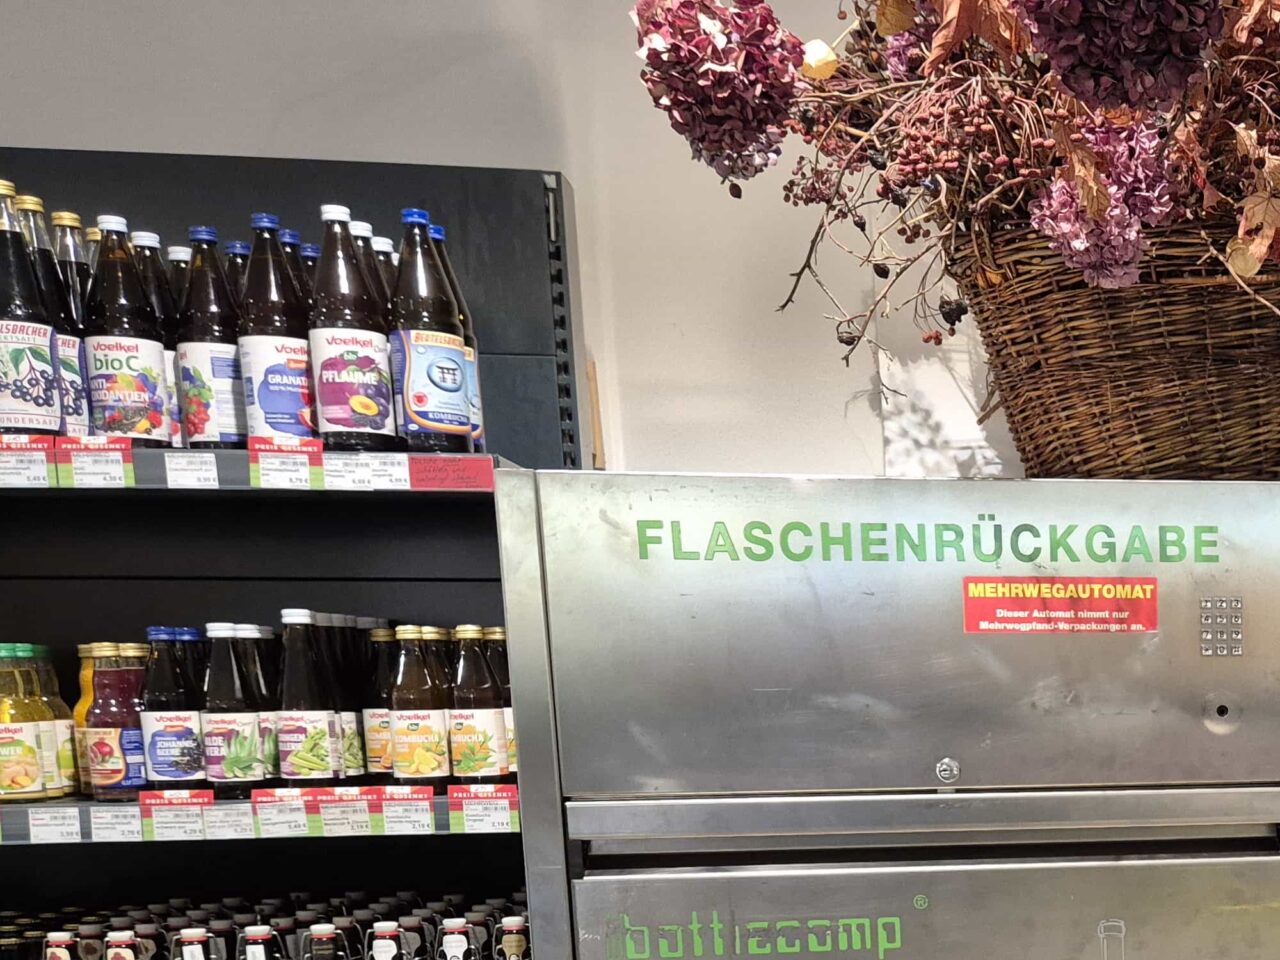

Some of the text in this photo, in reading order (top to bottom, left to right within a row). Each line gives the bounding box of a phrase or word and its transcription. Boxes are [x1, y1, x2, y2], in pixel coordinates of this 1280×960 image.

[93, 353, 140, 372] bio C
[322, 370, 378, 385] PFLAUME
[636, 514, 1221, 563] FLASCHENRÜCKGABE
[968, 582, 1154, 599] MEHRWEGAUTOMAT
[996, 609, 1030, 618] Dieser
[1032, 609, 1075, 618] Automat
[1078, 609, 1109, 618] nimmt
[1130, 623, 1146, 631] an.
